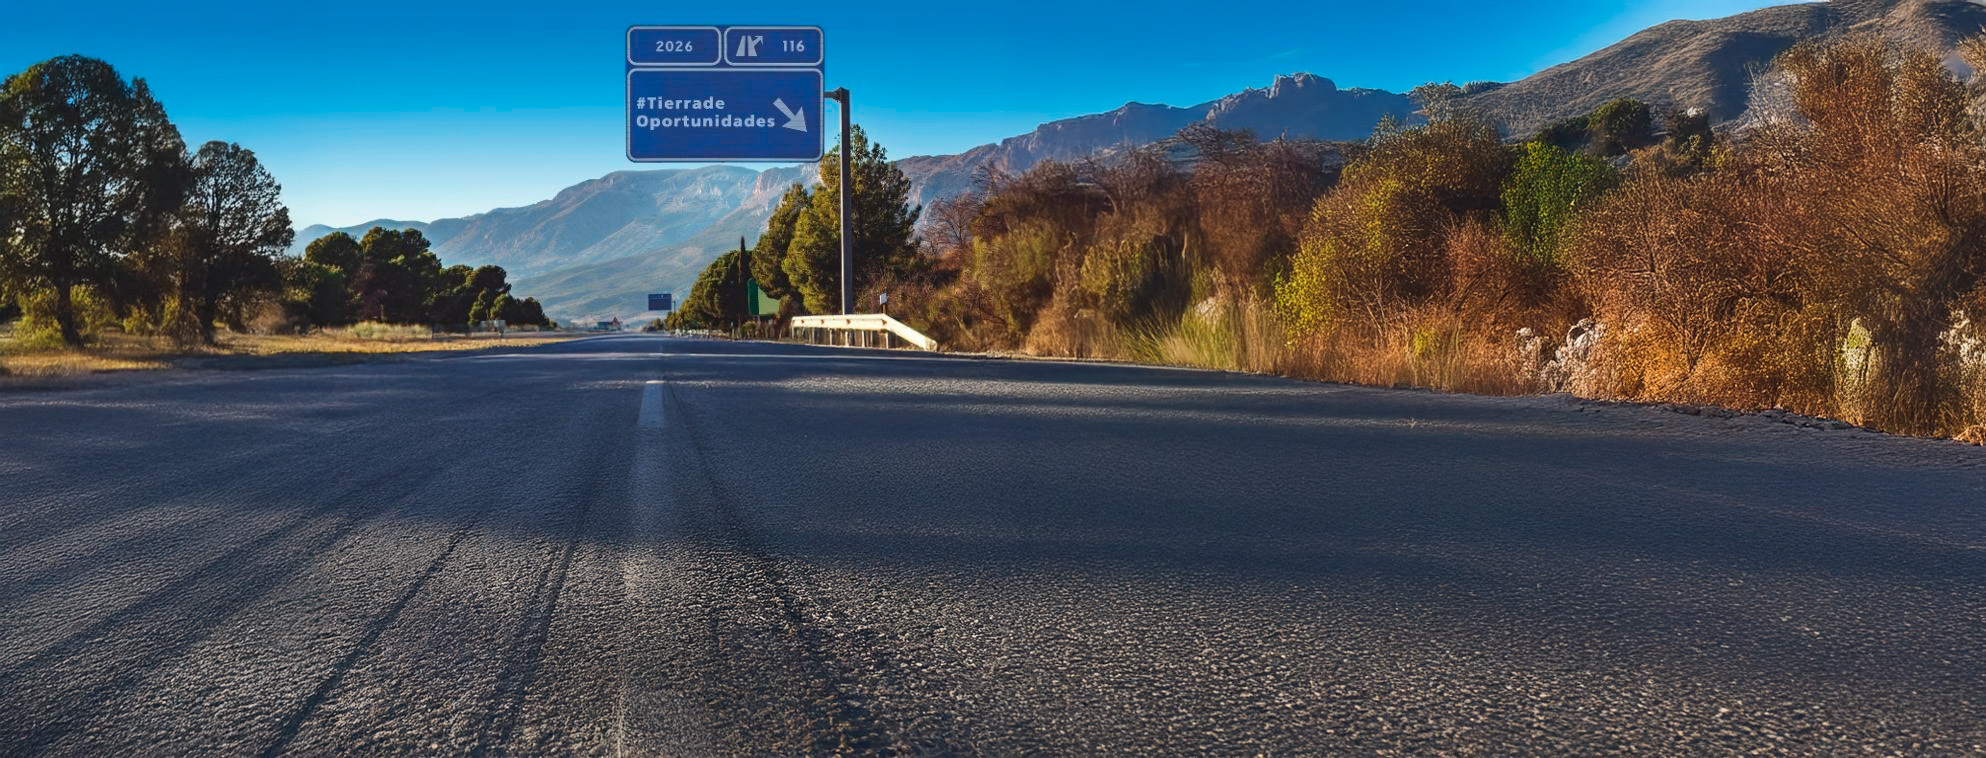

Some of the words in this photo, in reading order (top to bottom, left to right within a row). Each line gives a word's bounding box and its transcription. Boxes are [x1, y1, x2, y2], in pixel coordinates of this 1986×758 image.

[655, 40, 694, 53] 2026
[782, 40, 806, 53] 116
[636, 96, 726, 110] #Tierrade
[636, 114, 776, 131] Oportunidades
